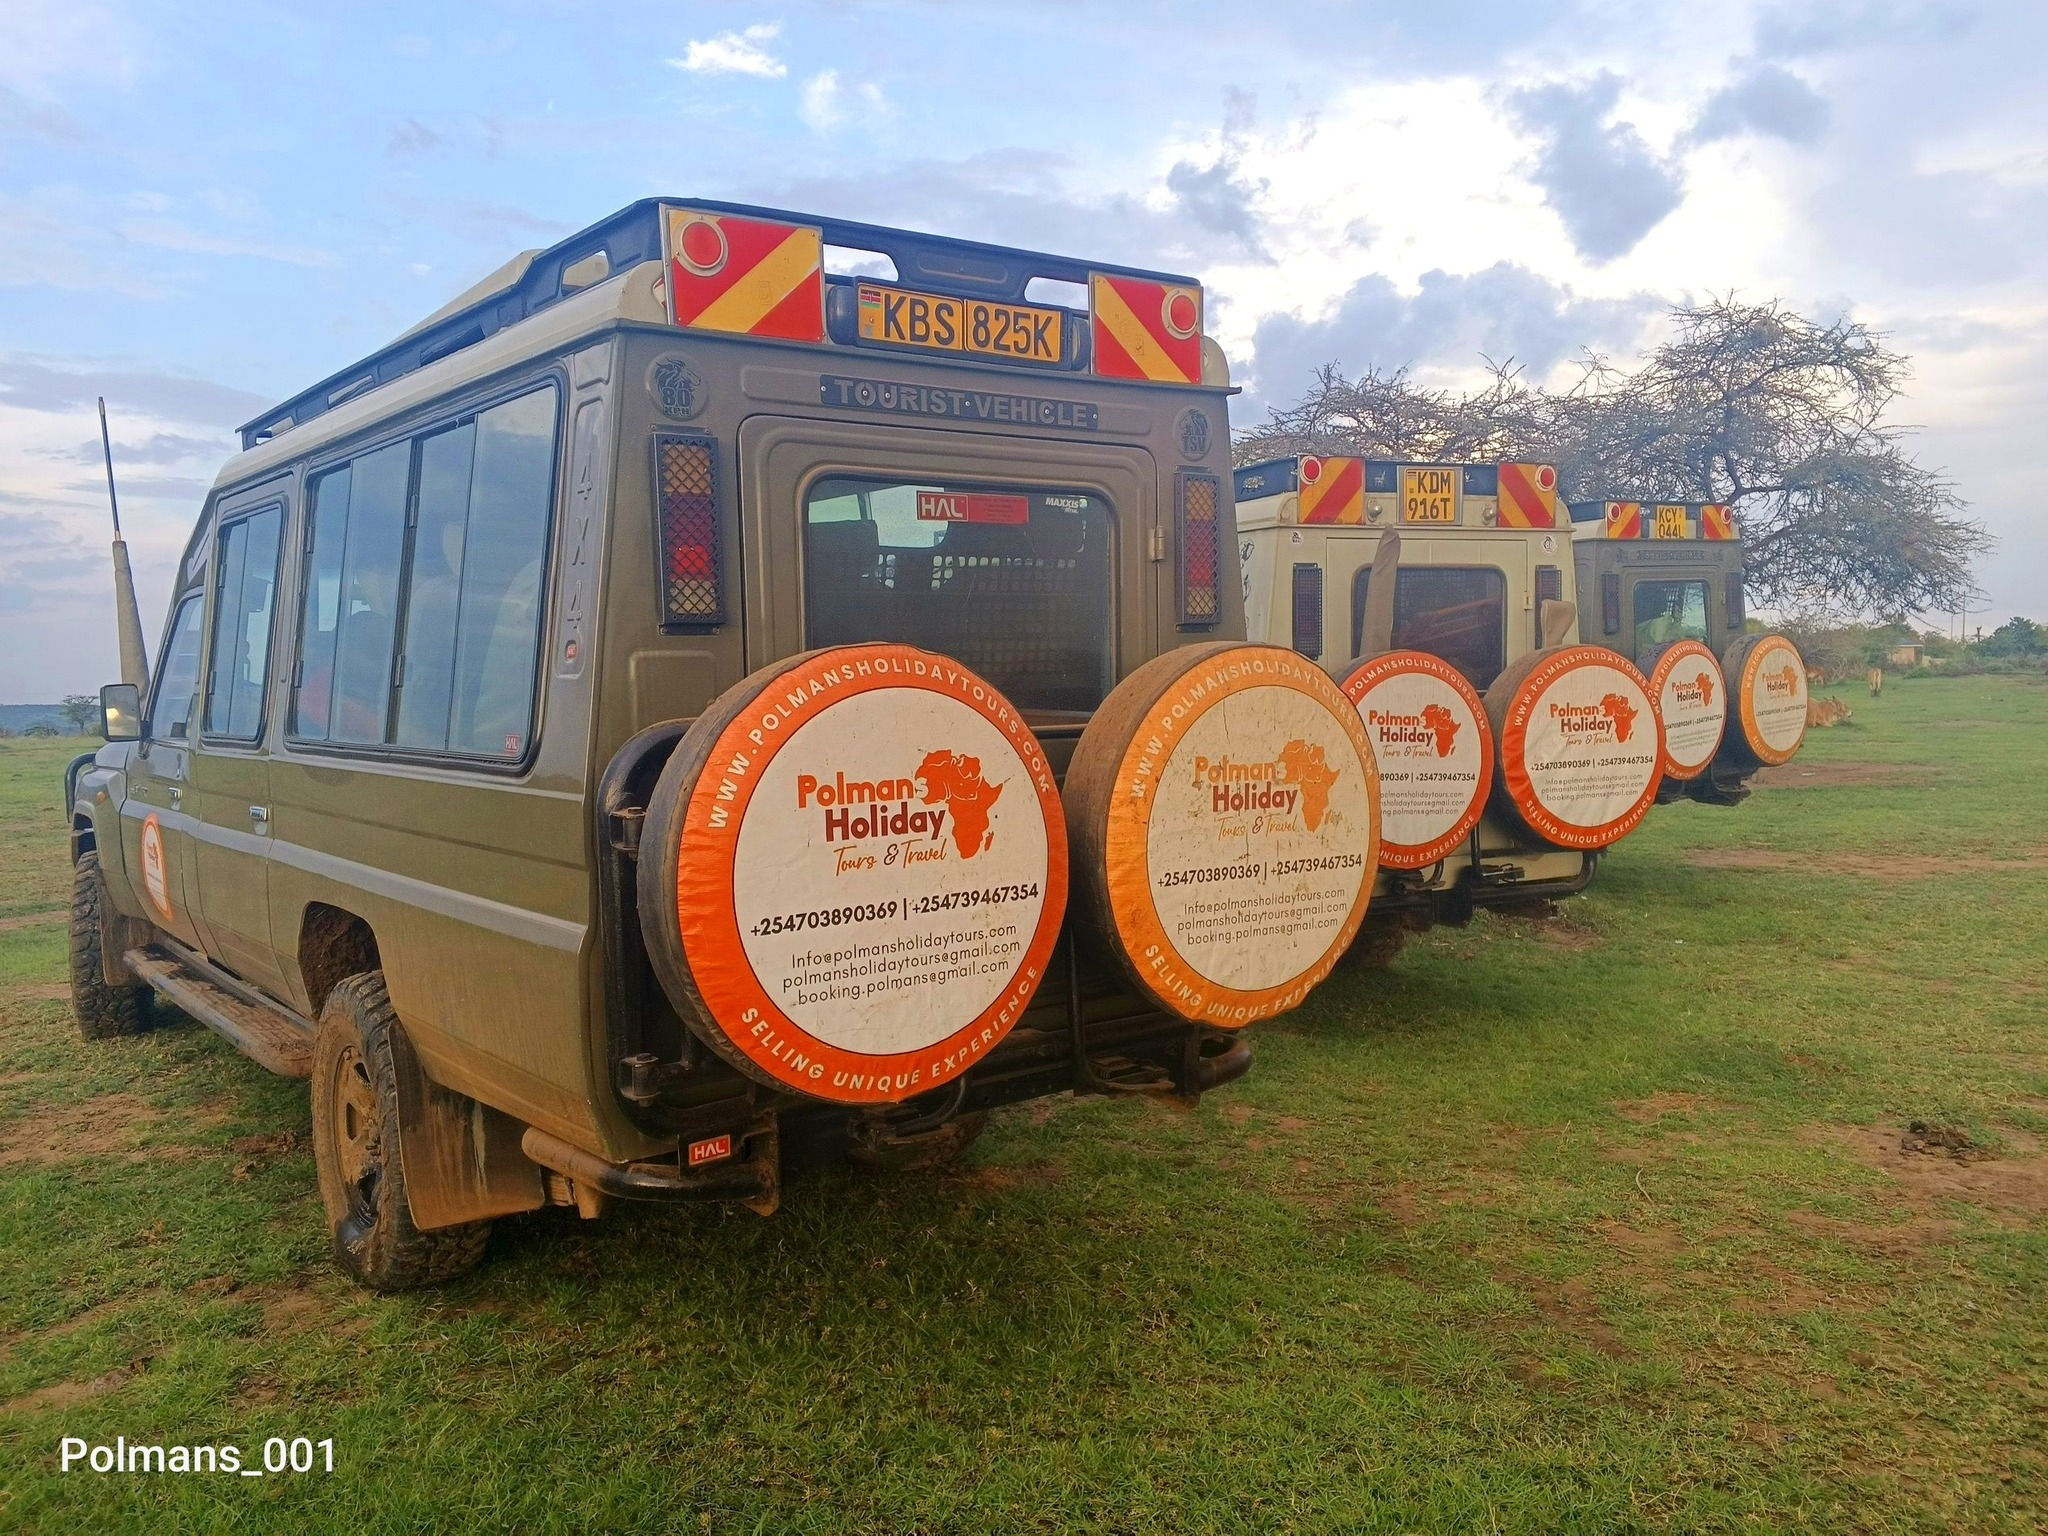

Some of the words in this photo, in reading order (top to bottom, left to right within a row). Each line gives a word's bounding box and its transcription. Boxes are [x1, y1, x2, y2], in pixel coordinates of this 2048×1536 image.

[883, 293, 955, 346] KBS
[972, 305, 1053, 358] 825K
[834, 379, 967, 415] TOURIST
[973, 394, 1089, 427] VEHICLE
[1417, 471, 1451, 494] KDM
[1044, 497, 1079, 508] MAXXIS
[1408, 497, 1451, 519] 916T
[1658, 508, 1678, 523] KCY
[1658, 523, 1684, 539] 044L
[1349, 658, 1486, 731] .POLMANSHOLIDAYTOURS.COM
[1514, 651, 1661, 727] WWW.POLMANSHOLIDAYTOURS.COM
[1677, 690, 1702, 702] Holiday
[1368, 710, 1427, 727] Polmans
[1550, 702, 1606, 718] Polmans
[1560, 718, 1613, 734] Holiday
[707, 657, 1050, 829] WWW.POLMANSHOLIDAYTOURS.COM
[1379, 727, 1434, 747] Holiday
[1194, 757, 1288, 785] Polmans
[1415, 773, 1476, 782] +254739467354
[1530, 760, 1591, 771] +254703890369
[1597, 756, 1653, 767] +254739467354
[797, 771, 929, 810] Polmans
[1212, 784, 1299, 814] Holiday
[1380, 790, 1464, 800] polmansholidaytours.com
[825, 802, 946, 842] Holiday
[1264, 813, 1298, 837] Travel
[1526, 800, 1557, 835] SELLING
[1560, 831, 1598, 844] UNIQUE
[1602, 795, 1652, 841] EXPERIENCE
[1419, 814, 1475, 861] EXPERIENCE
[833, 845, 878, 877] Tours
[900, 839, 947, 869] Travel
[1157, 863, 1260, 888] +254703890369
[1270, 853, 1362, 877] +254739467354
[750, 901, 898, 937] +254703890369
[911, 883, 1039, 914] +254739467354
[791, 923, 1017, 969] Info@polmansholidaytours.com
[782, 939, 1021, 992] polmansholidaytours@gmail.com
[798, 958, 1010, 1006] booking.polmans@gmail.com
[1144, 944, 1202, 1007] SELLING
[1206, 1001, 1269, 1020] UNIQUE
[741, 1007, 824, 1079] SELLING
[833, 1069, 921, 1092] UNIQUE
[931, 966, 1038, 1079] EXPERIENCE
[694, 1141, 725, 1160] HAL
